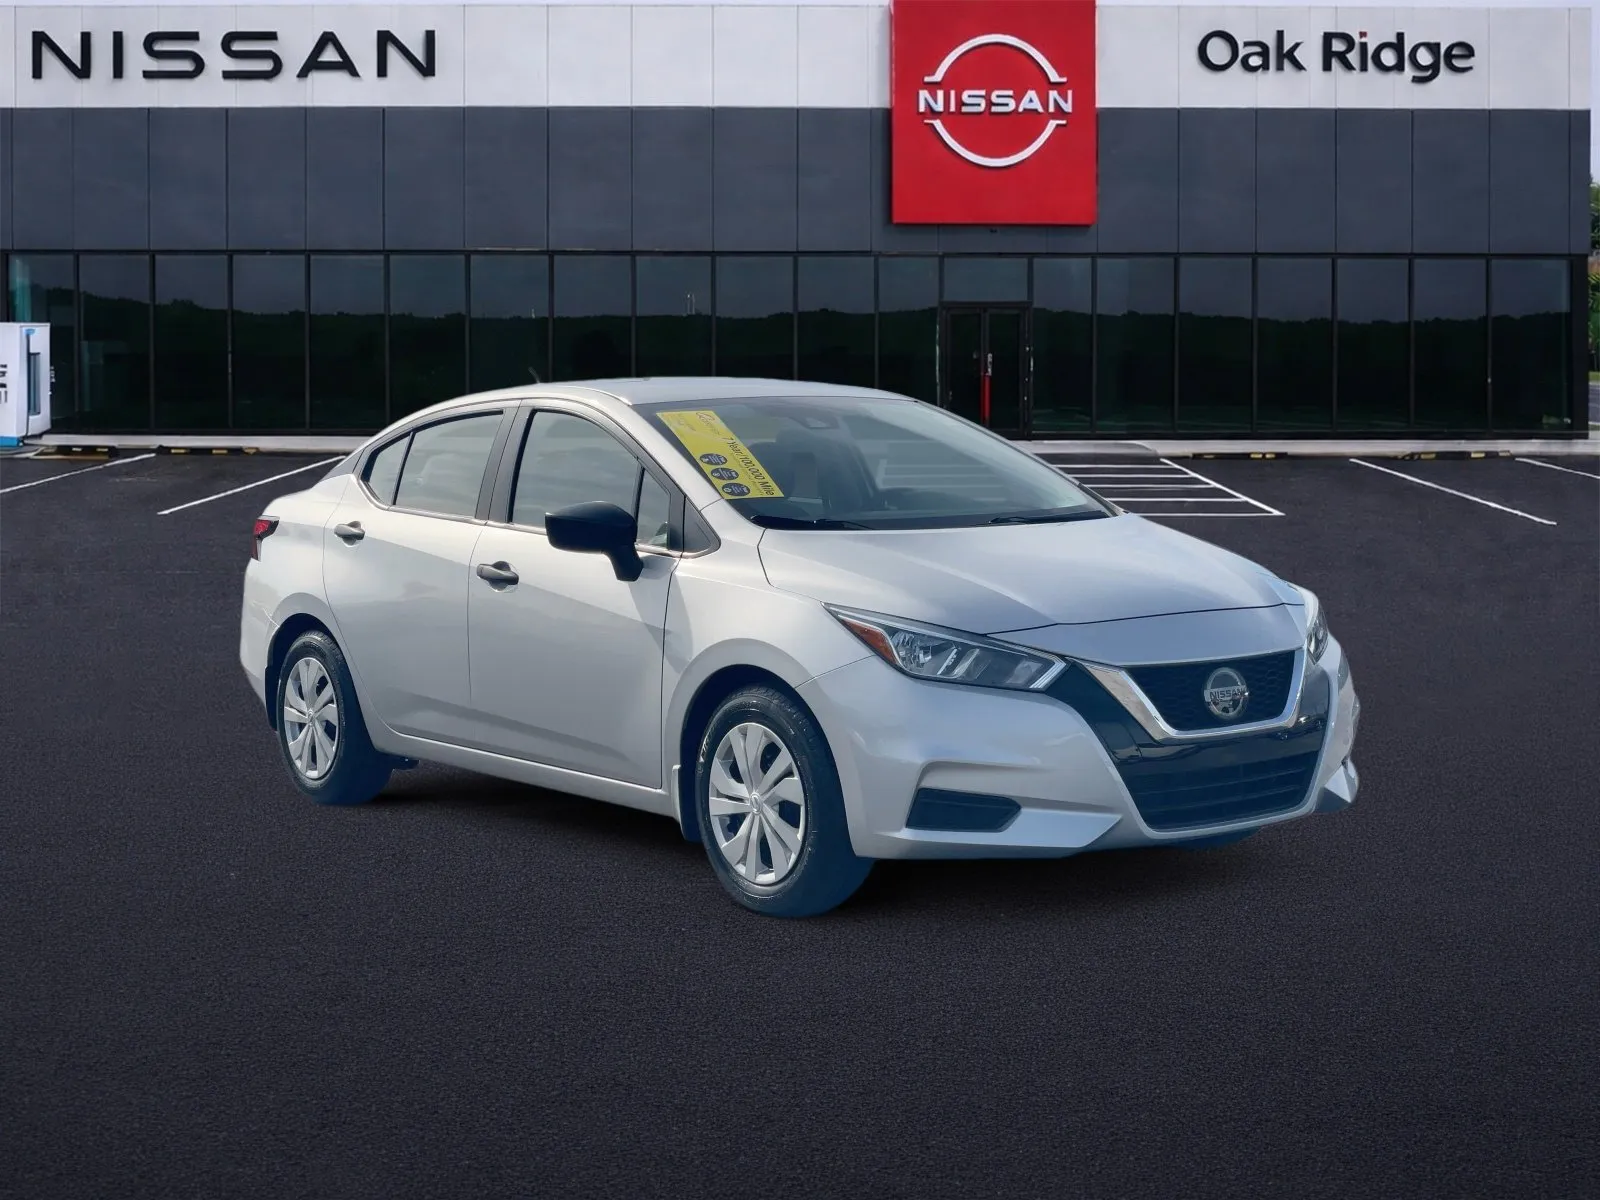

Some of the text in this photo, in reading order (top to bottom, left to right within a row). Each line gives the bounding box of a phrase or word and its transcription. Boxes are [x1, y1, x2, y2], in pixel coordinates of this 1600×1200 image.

[32, 30, 436, 81] NISSAN
[1198, 30, 1476, 84] Oak Ridge
[918, 89, 1073, 114] NISSAN
[1209, 687, 1246, 700] NISSAN
